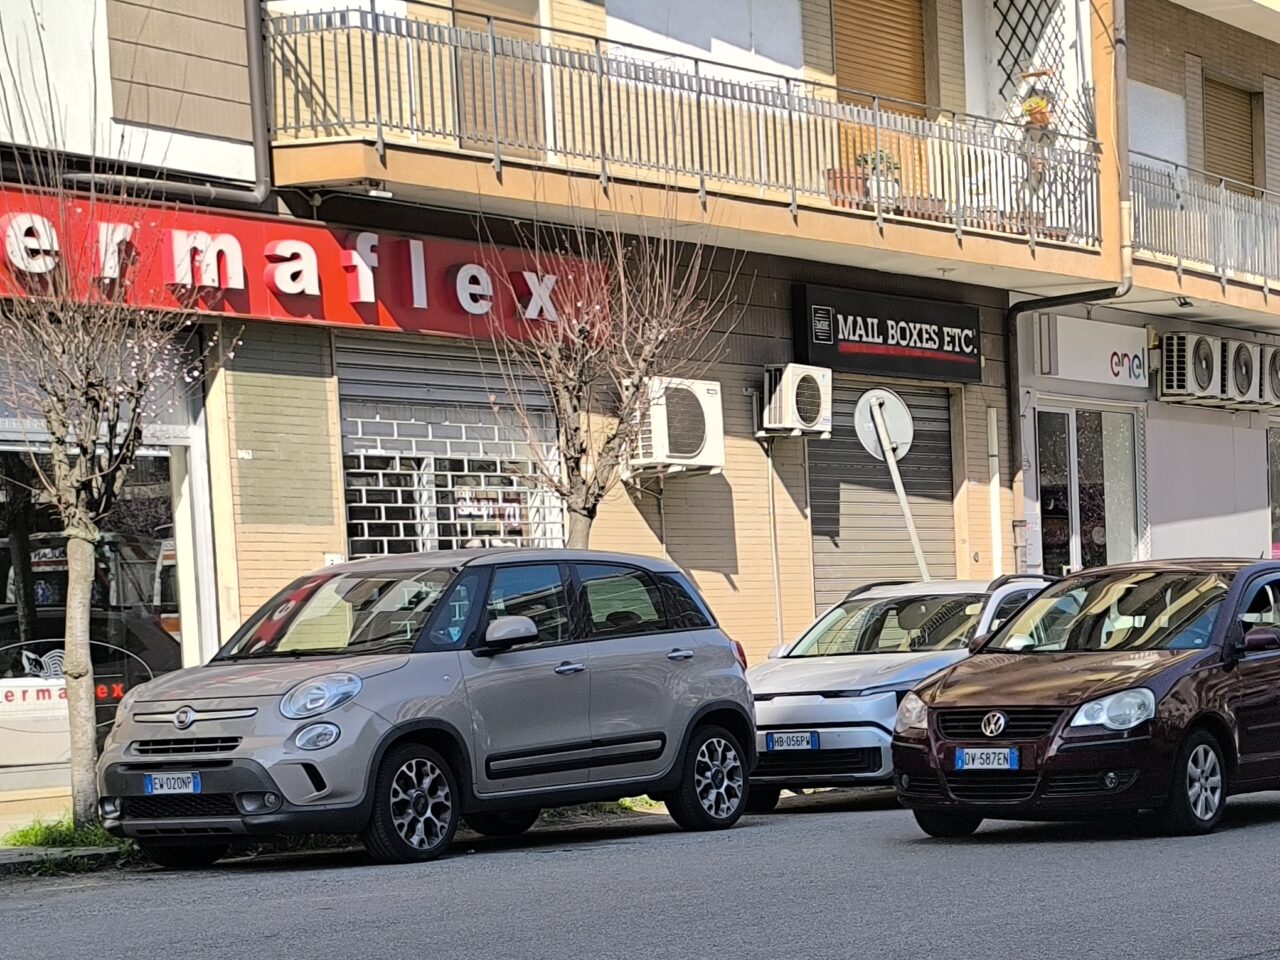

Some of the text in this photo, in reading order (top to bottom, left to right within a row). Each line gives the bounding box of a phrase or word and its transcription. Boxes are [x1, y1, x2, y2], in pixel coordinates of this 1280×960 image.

[3, 212, 559, 321] ermaflex
[836, 314, 978, 354] MAIL BOXES ETC.
[1110, 347, 1147, 380] enel
[4, 684, 126, 703] ermaex
